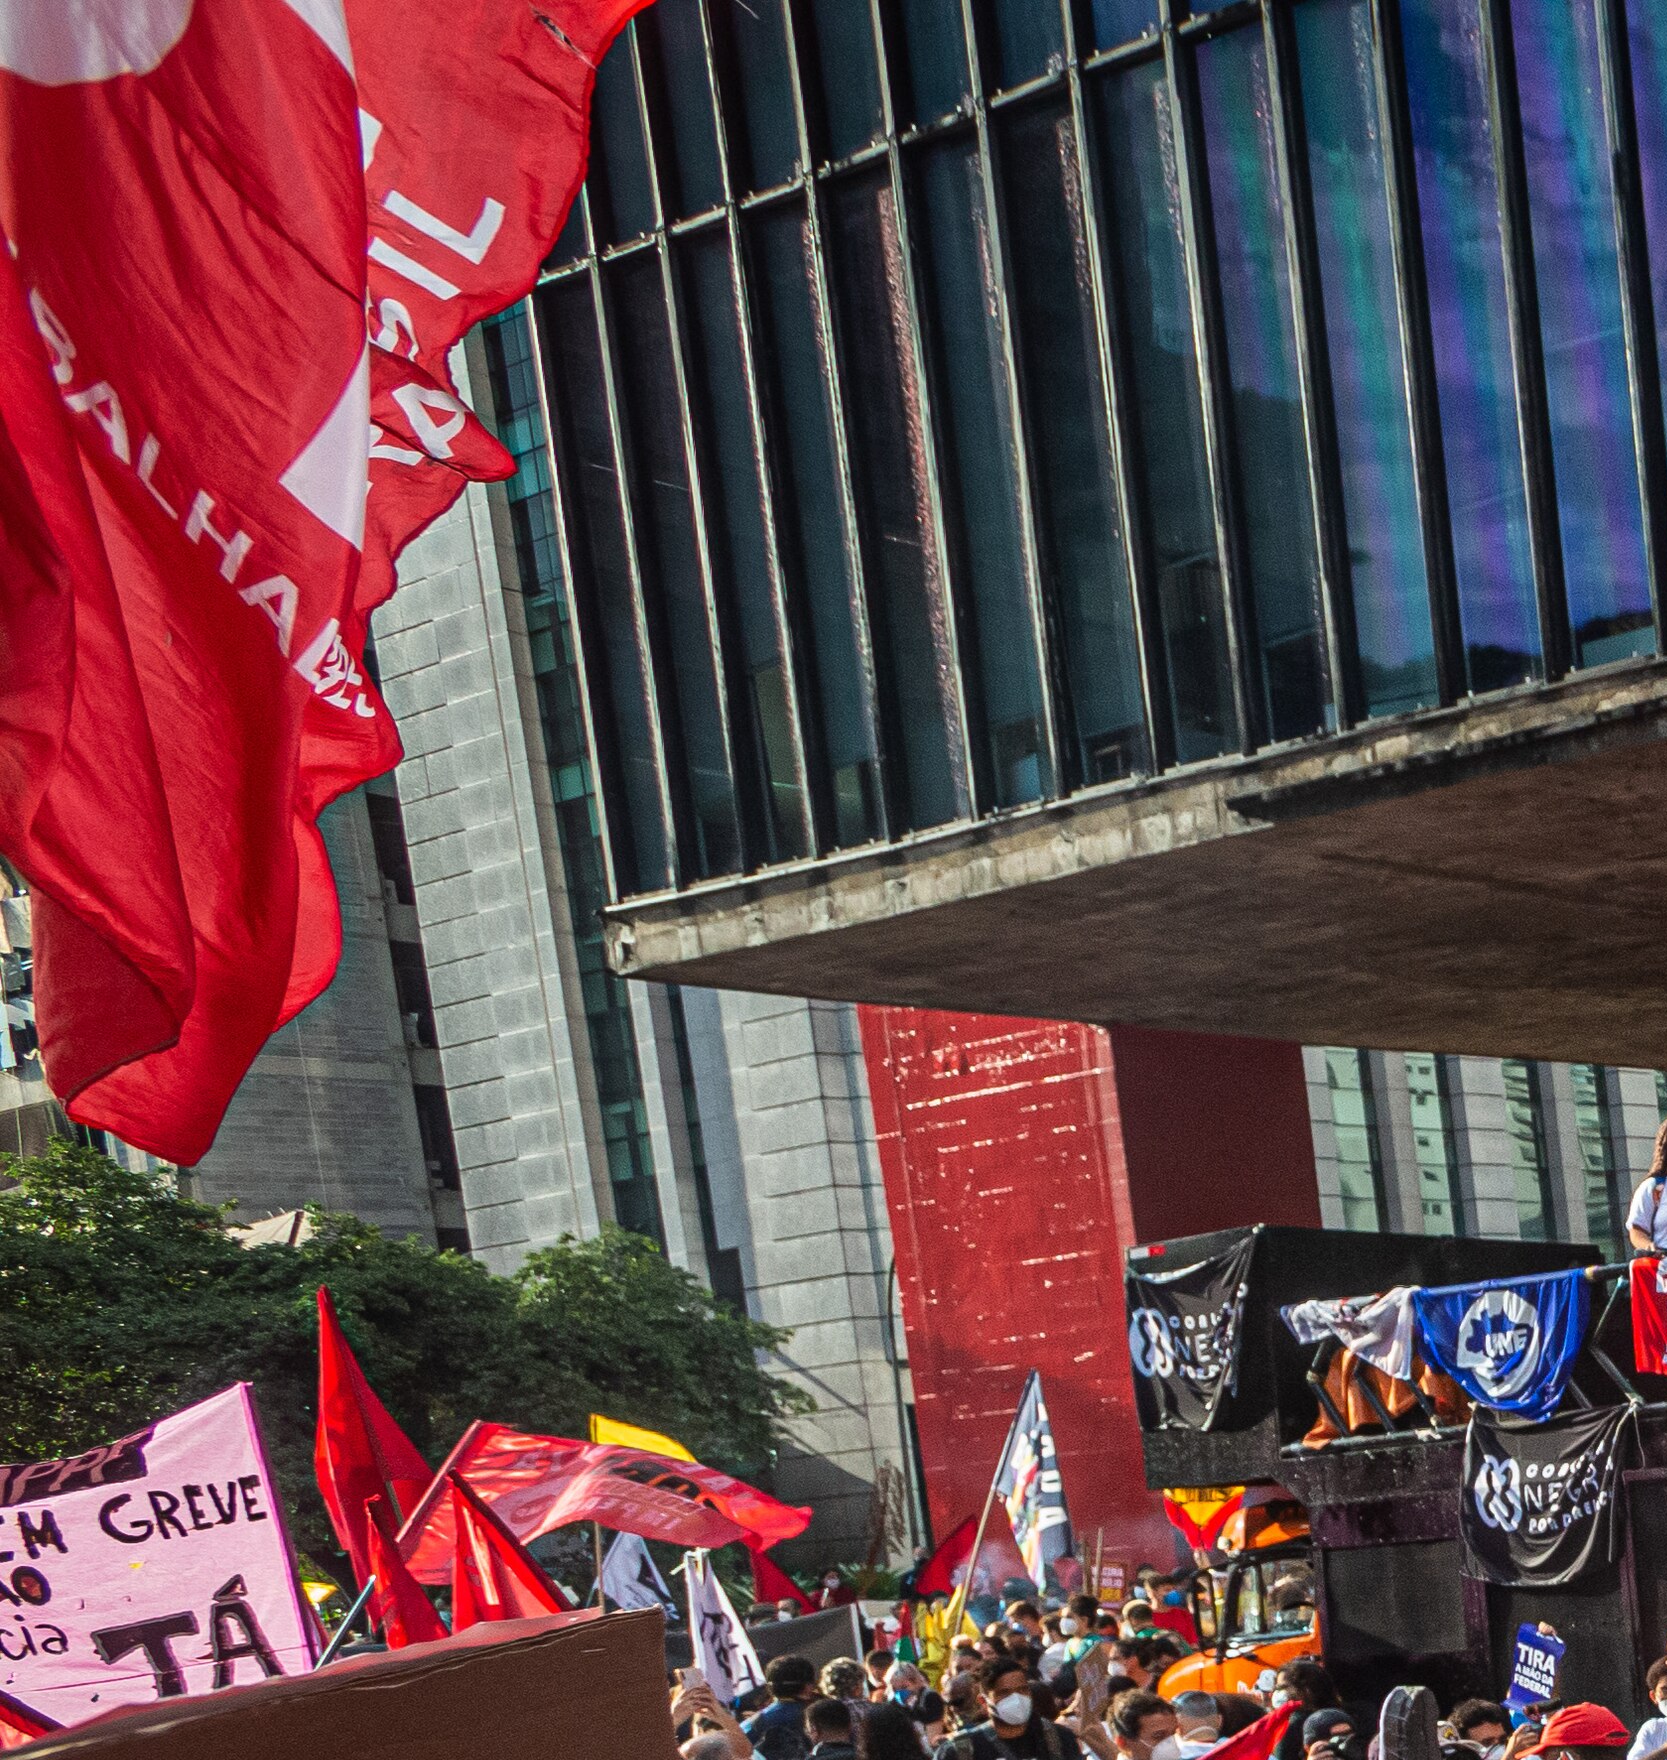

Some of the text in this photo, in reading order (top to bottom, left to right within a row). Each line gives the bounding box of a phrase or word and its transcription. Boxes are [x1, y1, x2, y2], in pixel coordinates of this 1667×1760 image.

[98, 1474, 269, 1544] GREVE
[1515, 1664, 1522, 1674] A
[1517, 1642, 1556, 1676] TIRA
[1513, 1672, 1552, 1699] FEDERAL
